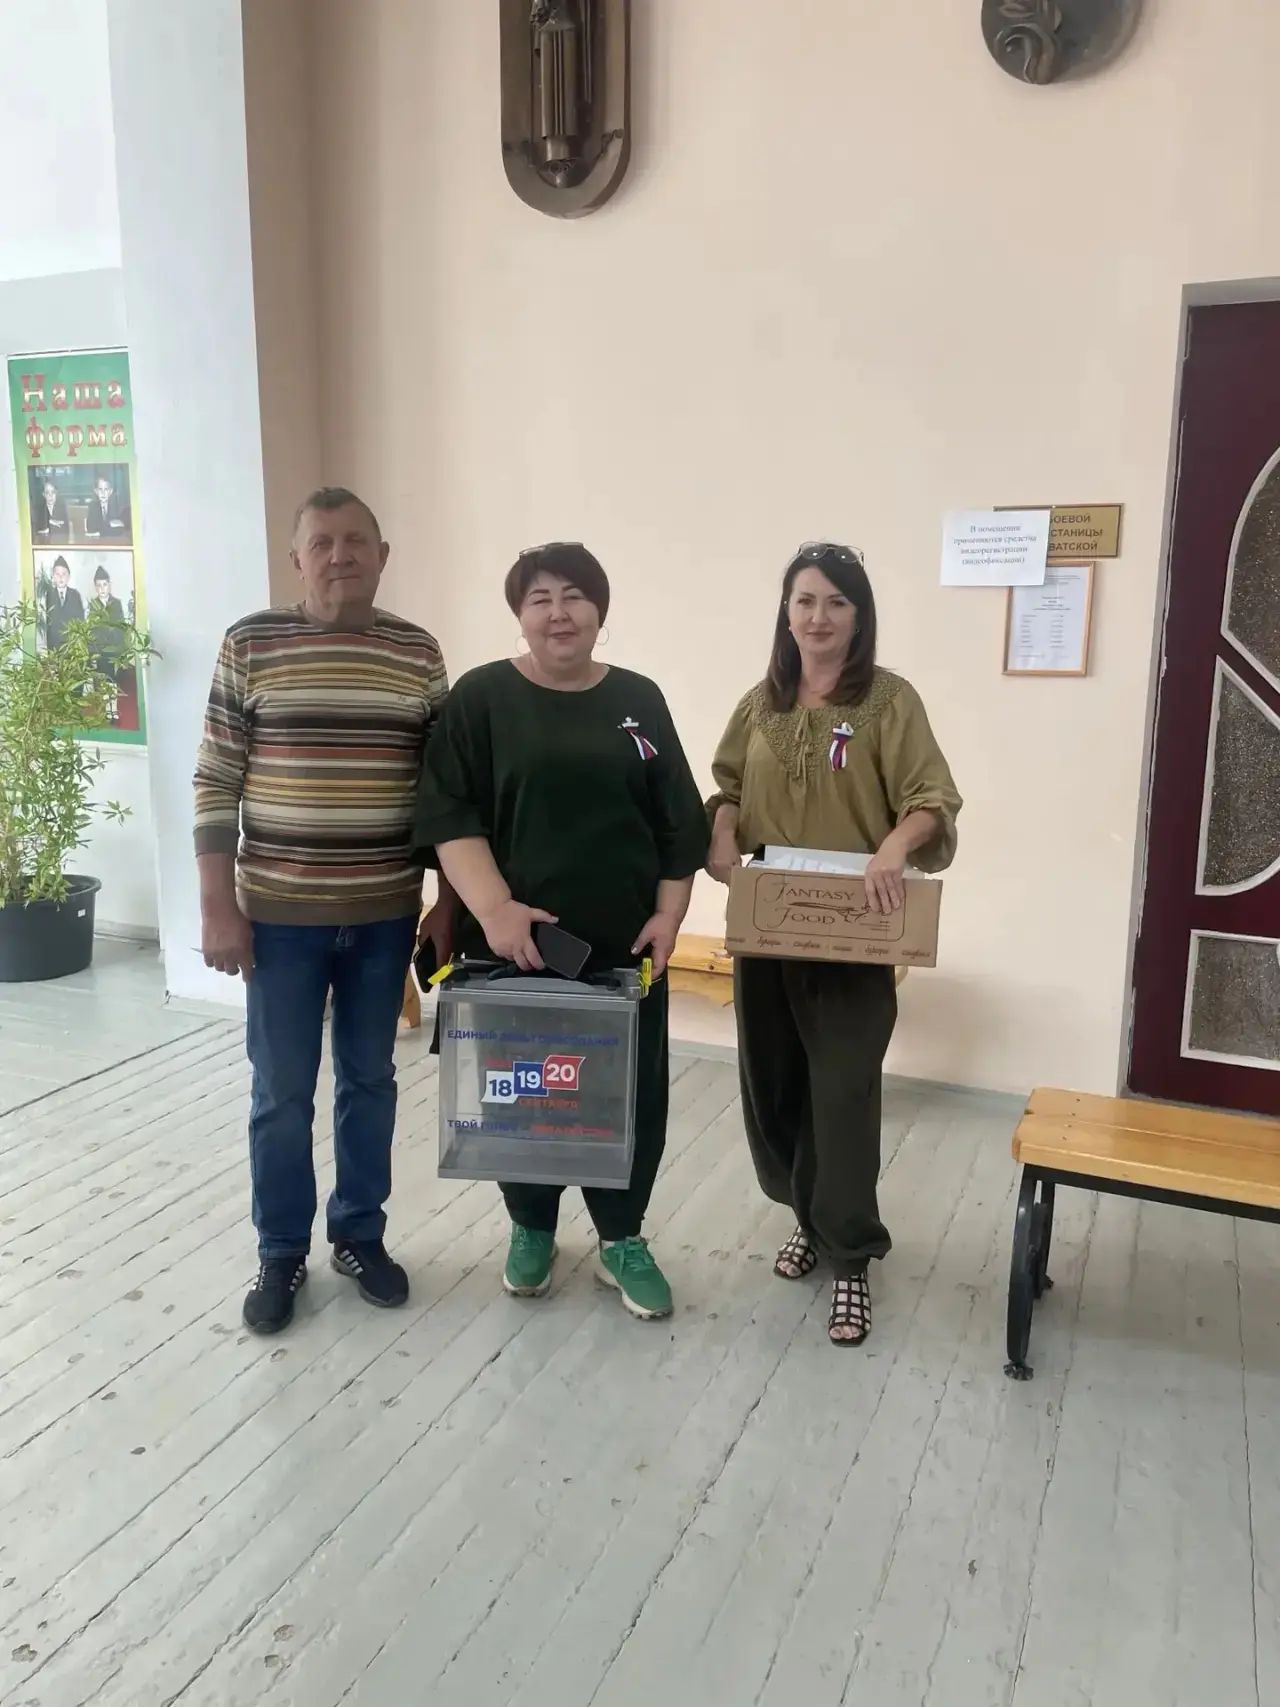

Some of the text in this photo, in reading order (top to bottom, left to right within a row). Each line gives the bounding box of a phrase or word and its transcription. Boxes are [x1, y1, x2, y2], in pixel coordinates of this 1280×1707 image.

[21, 373, 126, 412] Наша
[25, 416, 128, 458] форма
[1050, 528, 1104, 538] СТАНИЦЫ
[1049, 540, 1098, 551] ВАТСКОЙ
[447, 1029, 497, 1041] ЕДИНЫЙ
[488, 1063, 576, 1097] 18 19 20
[447, 1119, 478, 1129] ТВОЙ
